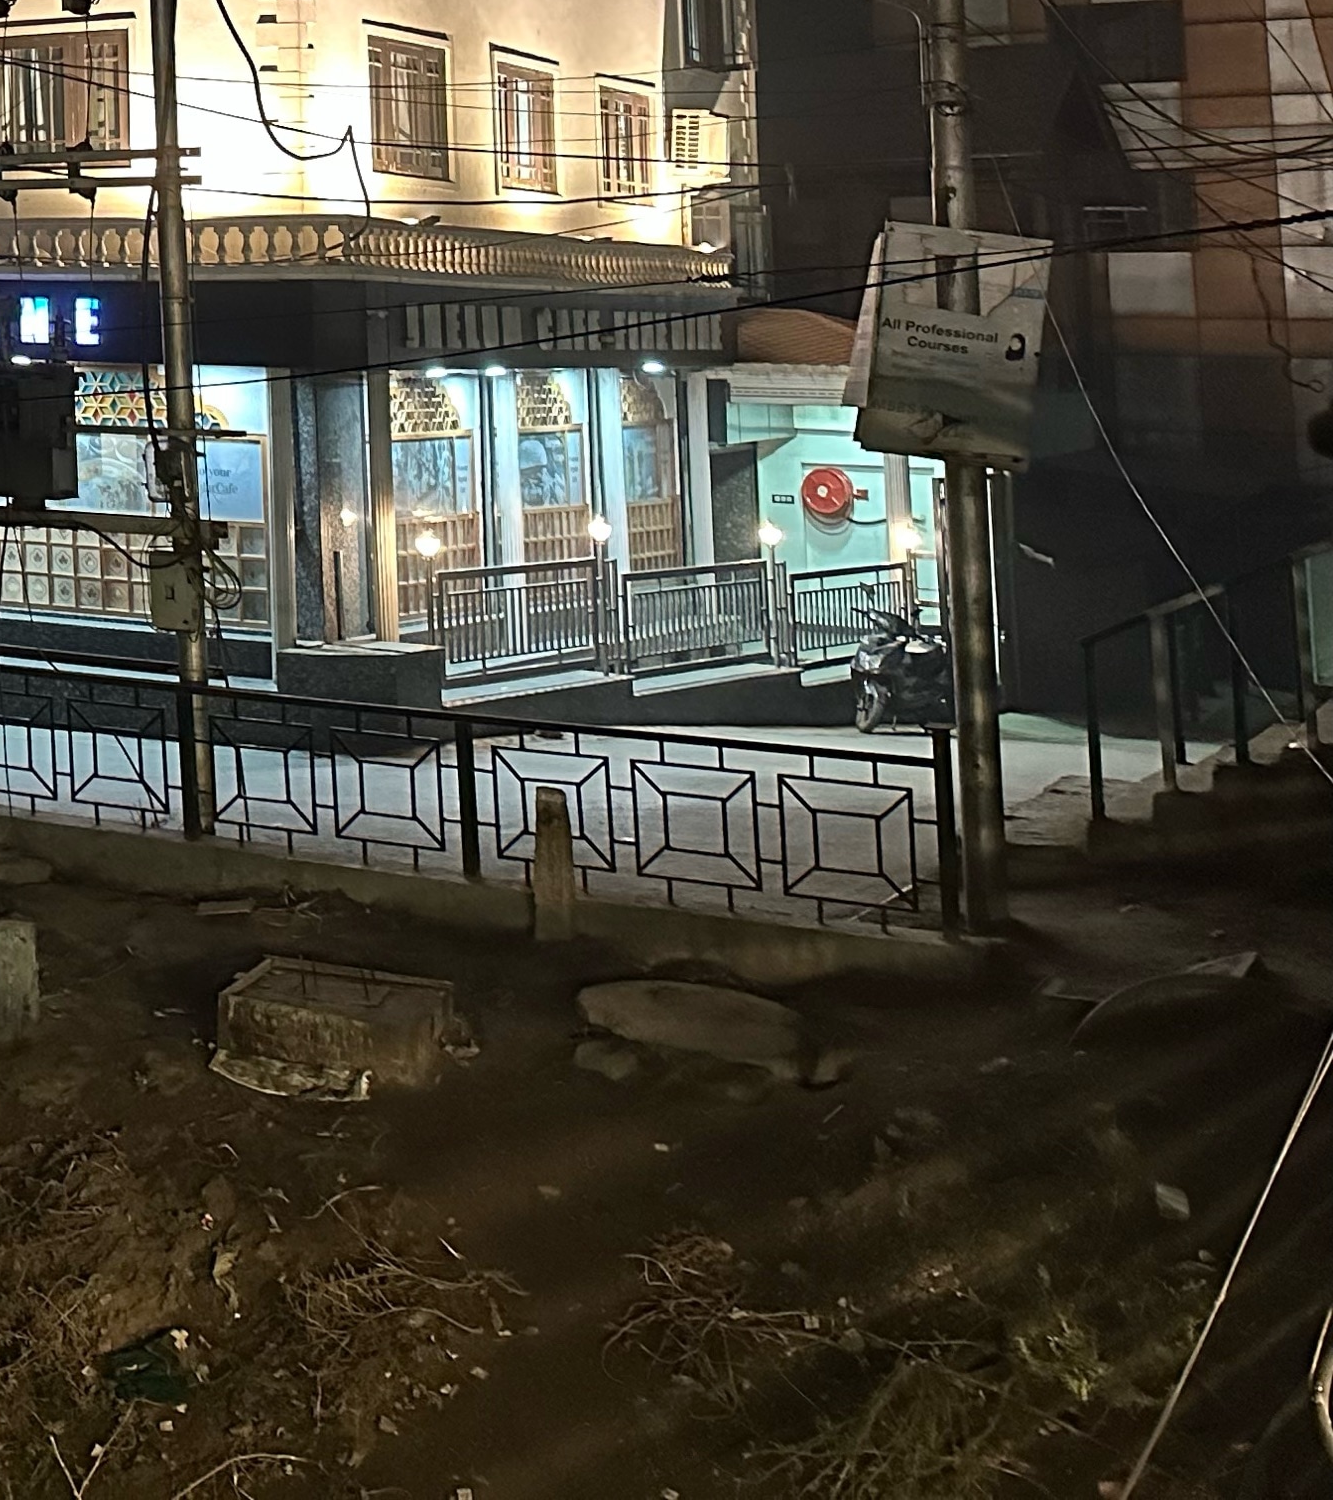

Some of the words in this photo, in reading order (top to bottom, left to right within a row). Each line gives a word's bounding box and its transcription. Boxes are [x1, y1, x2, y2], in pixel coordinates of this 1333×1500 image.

[881, 317, 901, 331] All
[904, 319, 999, 344] Professional
[906, 335, 970, 355] Courses
